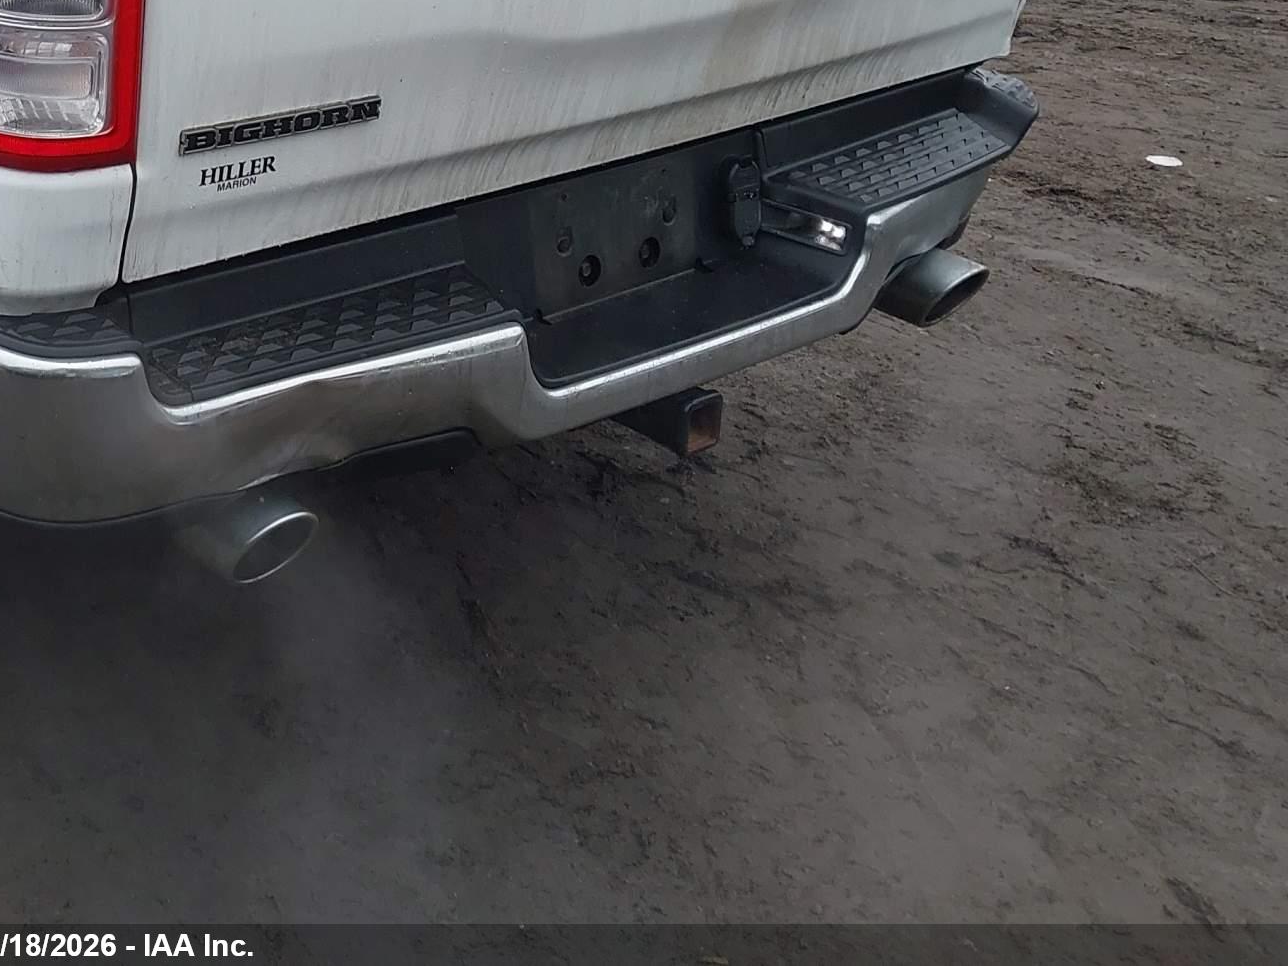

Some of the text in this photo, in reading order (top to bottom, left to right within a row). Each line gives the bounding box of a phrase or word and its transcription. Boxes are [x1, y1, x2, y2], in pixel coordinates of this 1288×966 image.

[179, 94, 382, 156] BIGHORN
[198, 155, 276, 187] HILLER
[216, 175, 257, 192] MARION
